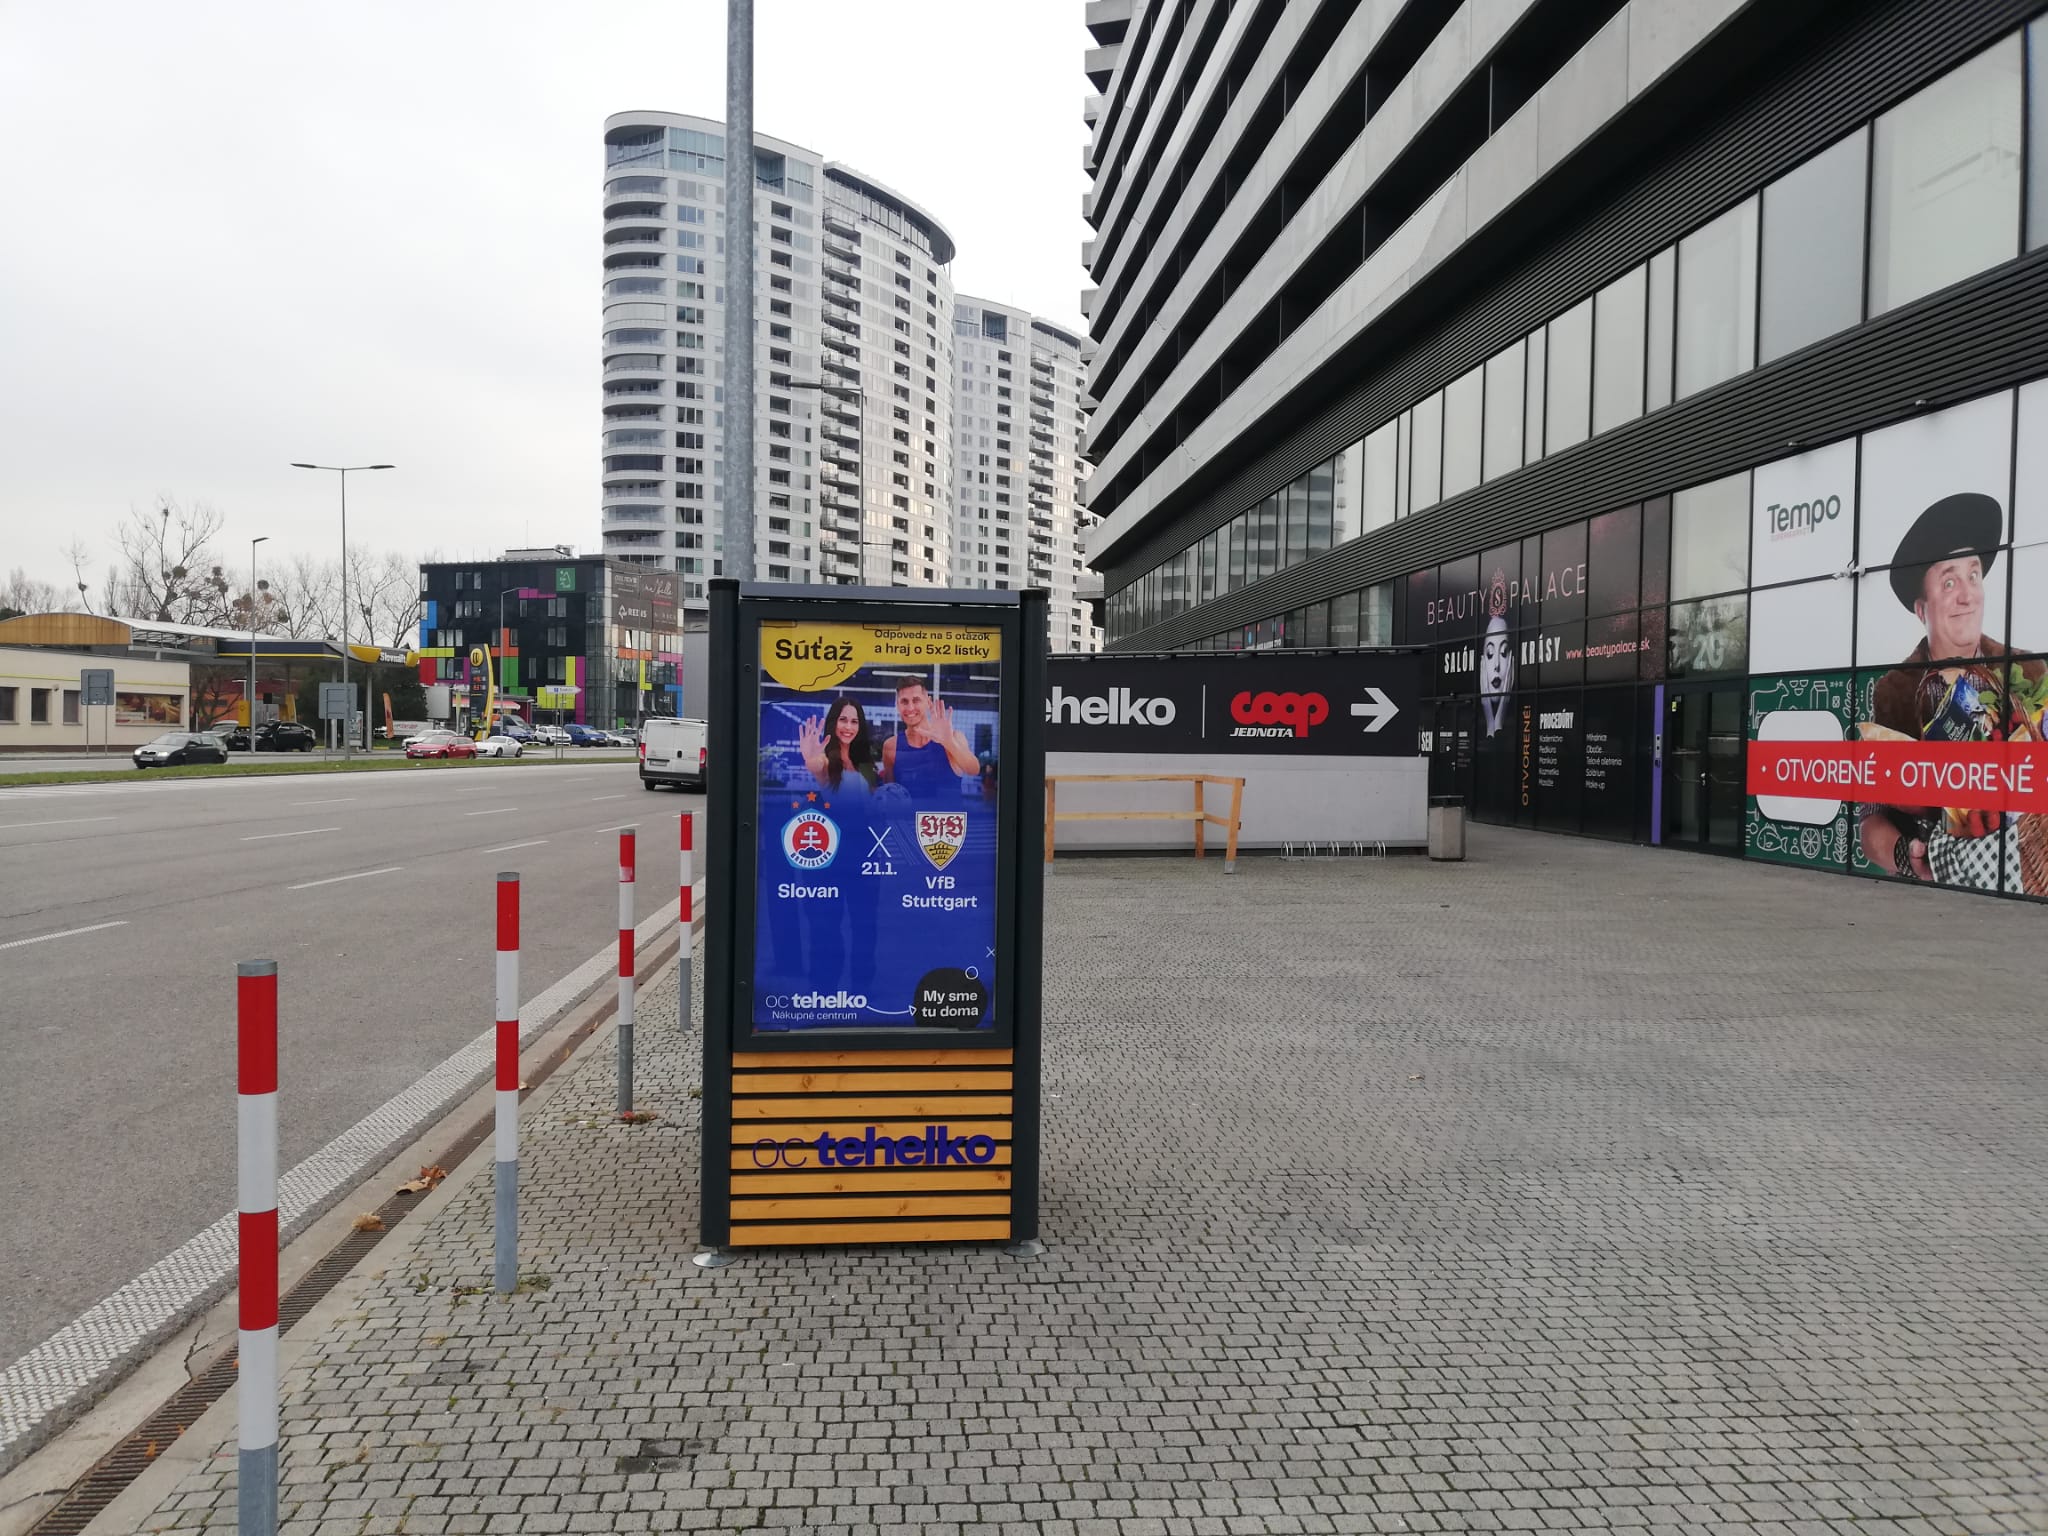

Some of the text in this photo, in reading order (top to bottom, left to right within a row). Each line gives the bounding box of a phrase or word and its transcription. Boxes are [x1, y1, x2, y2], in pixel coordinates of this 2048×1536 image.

[1767, 494, 1841, 533] Tempo
[1510, 563, 1586, 608] PALACE
[1427, 588, 1487, 625] BEAUTY
[874, 629, 927, 640] Odpovedz
[930, 631, 943, 640] na
[945, 631, 953, 640] 5
[775, 636, 853, 661] Súťaž
[874, 644, 882, 654] a
[885, 643, 911, 656] hraj
[914, 646, 922, 654] o
[926, 644, 951, 655] 5x2
[1444, 634, 1561, 674] SALÓN KRÁSY
[1231, 691, 1329, 737] coop
[1230, 728, 1293, 738] JEDNOTA
[1776, 752, 2034, 793] OTVORENÉ OTVORENÉ
[797, 814, 826, 823] SLOVAN
[861, 862, 897, 875] 21.1.
[925, 876, 956, 889] VfB
[777, 883, 839, 899] Slovan
[901, 894, 977, 911] Stuttgart
[765, 991, 867, 1009] OC tehelko
[923, 990, 978, 1004] My sme
[772, 1010, 857, 1022] Nákupné centrum
[922, 1005, 979, 1017] tu doma
[814, 1125, 996, 1166] tehelko
